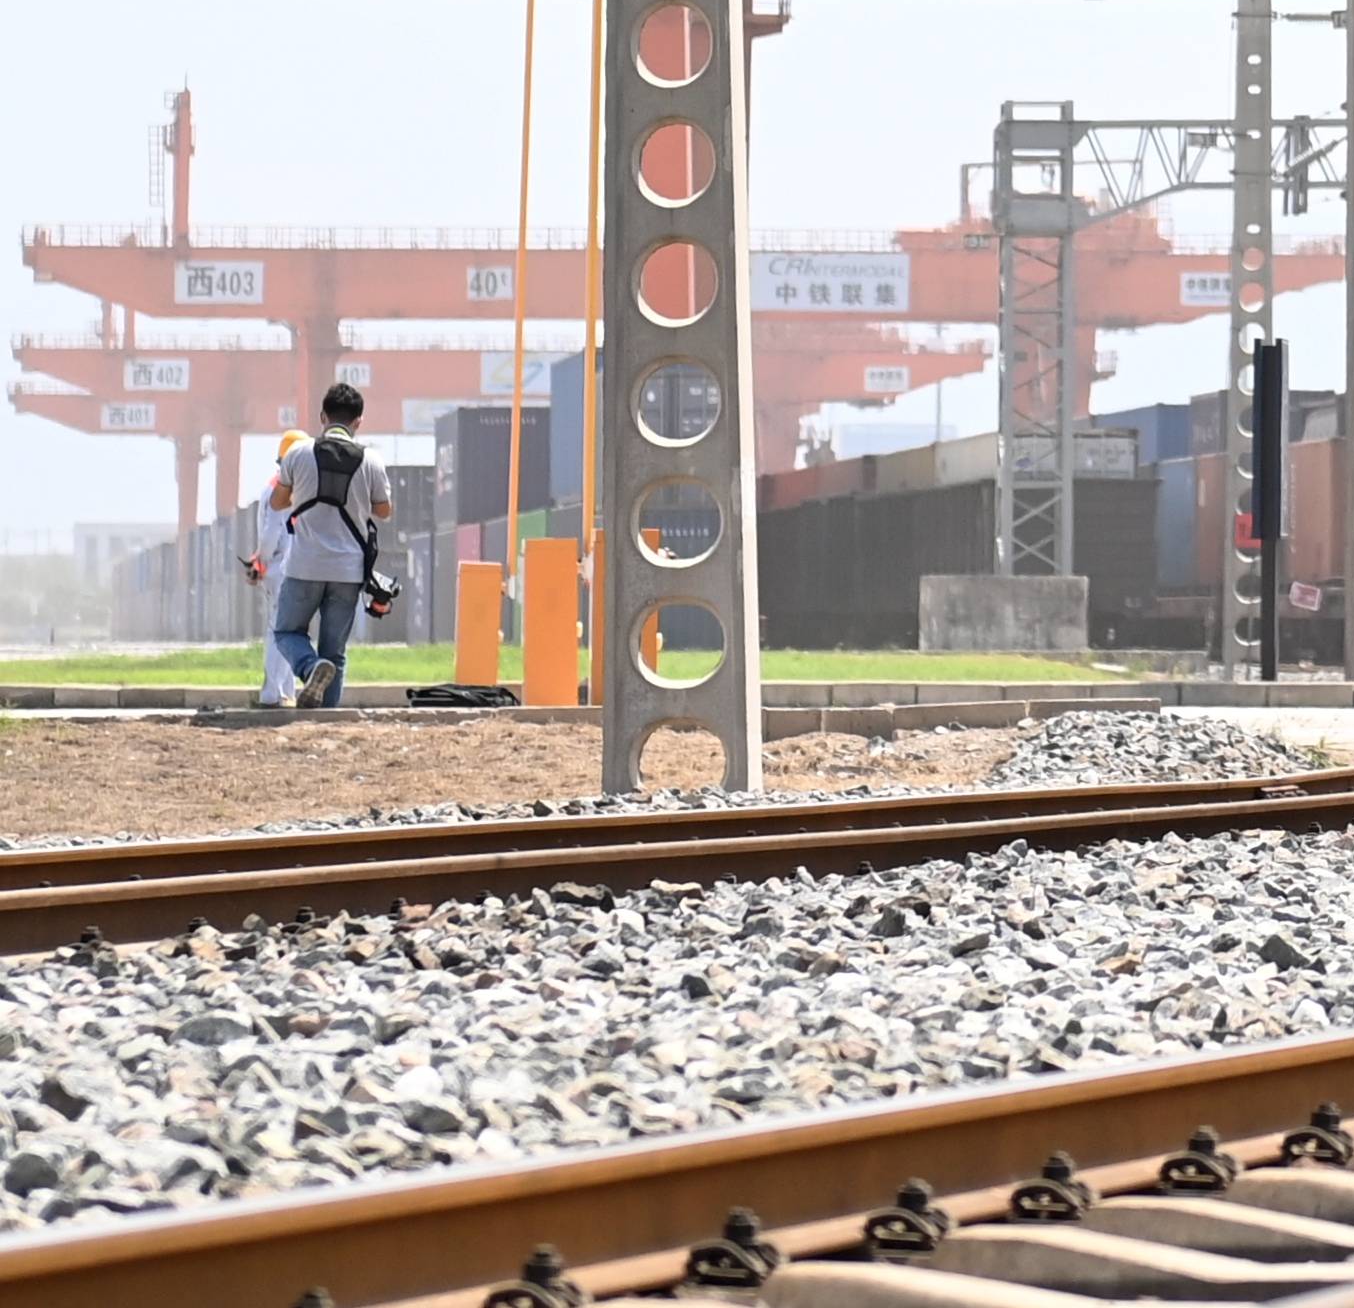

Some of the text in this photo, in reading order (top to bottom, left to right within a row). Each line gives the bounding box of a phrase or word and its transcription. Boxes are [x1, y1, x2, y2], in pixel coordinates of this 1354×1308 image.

[186, 264, 255, 297] 西403
[775, 282, 896, 305] 中铁联集
[131, 361, 184, 386] 西402
